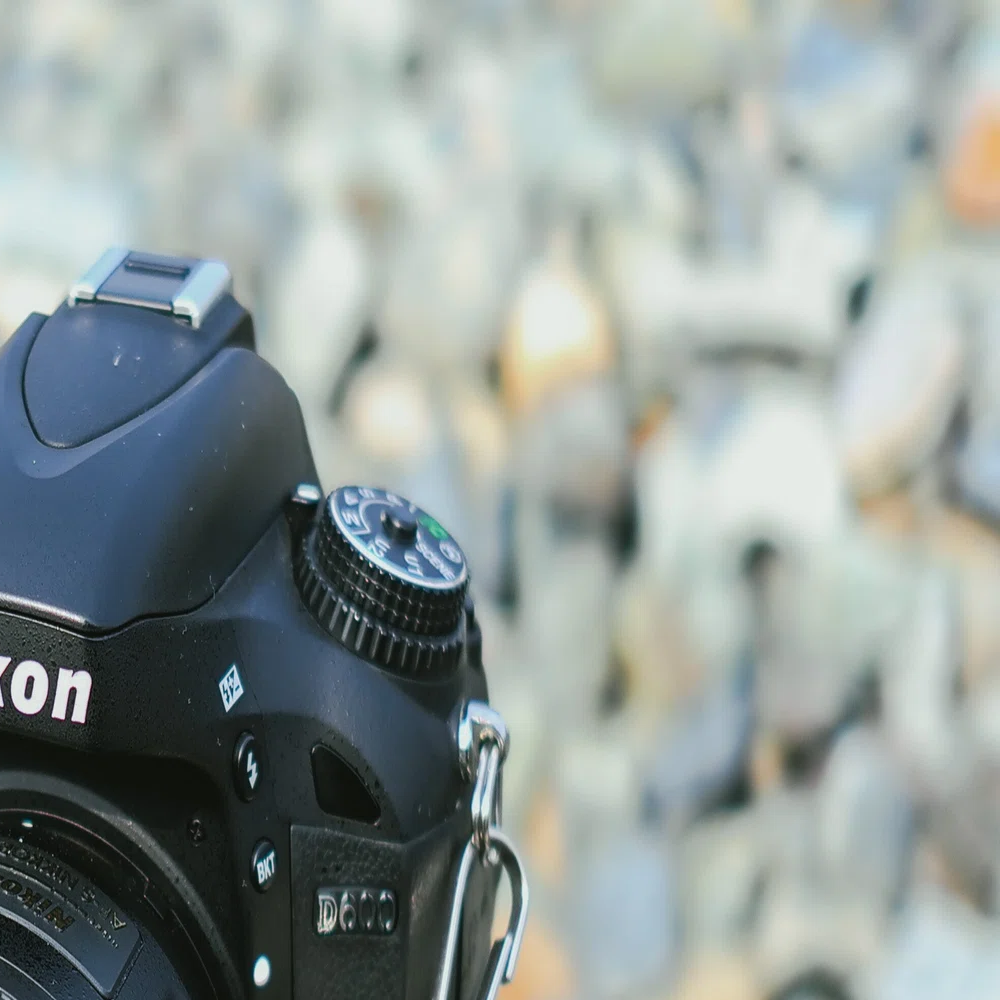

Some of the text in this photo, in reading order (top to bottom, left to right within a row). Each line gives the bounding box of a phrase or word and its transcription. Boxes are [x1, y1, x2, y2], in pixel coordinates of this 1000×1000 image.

[367, 534, 391, 558] U2
[415, 541, 457, 581] SCENE
[404, 551, 424, 577] U1
[256, 851, 277, 885] BKT
[317, 889, 397, 935] D600
